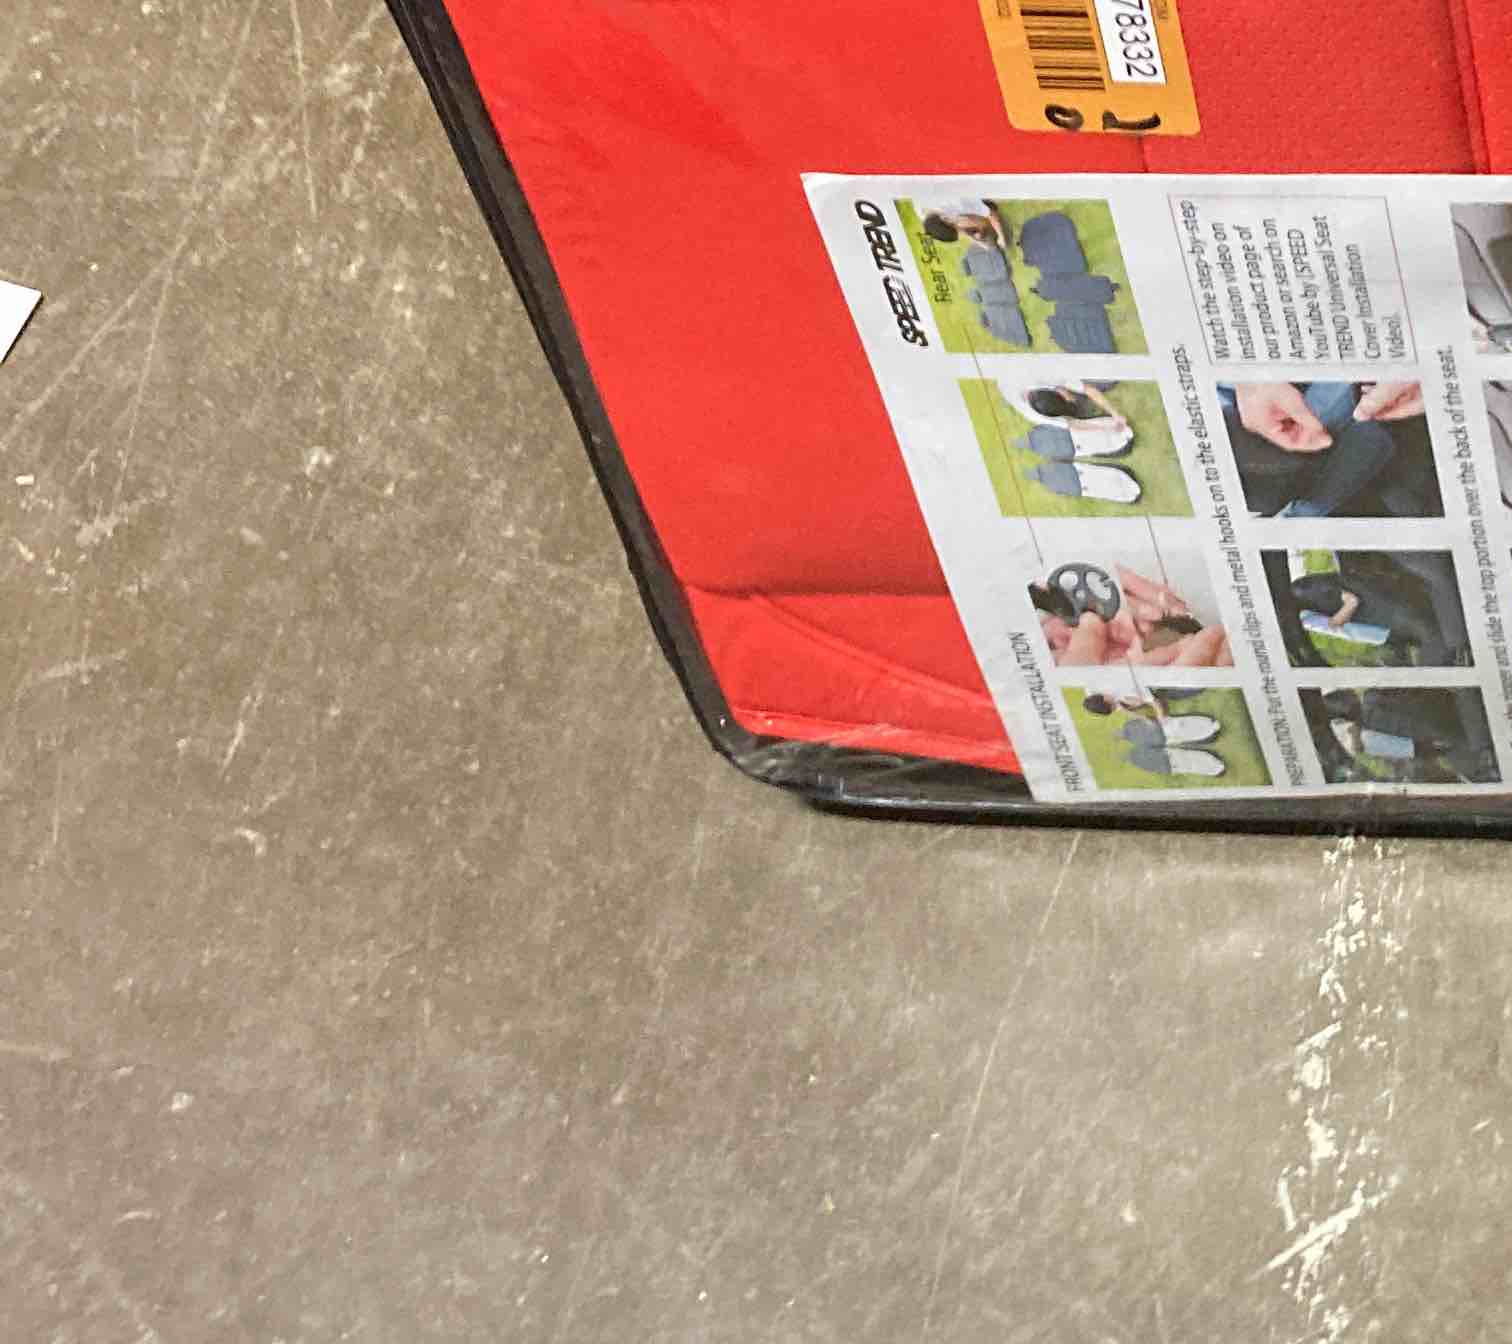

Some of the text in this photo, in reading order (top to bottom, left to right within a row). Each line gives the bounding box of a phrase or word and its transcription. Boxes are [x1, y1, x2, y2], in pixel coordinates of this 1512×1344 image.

[855, 201, 901, 270] TREND
[912, 231, 953, 303] Rear Seat
[1181, 201, 1229, 358] Watch the step-by-step
[1211, 222, 1254, 358] installation video on
[1232, 224, 1280, 359] our product page of
[1262, 218, 1304, 358] Amazon or search on
[1300, 281, 1319, 299] by
[1308, 215, 1353, 358] TREND Universal Seat
[1346, 244, 1380, 359] Cover Installation
[1306, 301, 1328, 358] YouTube
[1172, 344, 1195, 391] straps.
[1437, 346, 1456, 378] seat.
[1442, 382, 1461, 405] the
[1184, 395, 1207, 438] elastic
[1443, 408, 1464, 423] of
[1196, 441, 1214, 464] the
[1449, 426, 1471, 458] back
[1205, 467, 1219, 481] to
[1457, 461, 1475, 484] the
[1209, 484, 1224, 501] on
[1464, 487, 1481, 516] over
[1213, 505, 1234, 543] hooks
[1471, 519, 1493, 566] portion
[1221, 547, 1246, 582] metal
[1480, 569, 1495, 591] top
[1232, 585, 1253, 608] and
[1482, 593, 1498, 613] the
[1242, 611, 1261, 638] clips
[1486, 616, 1504, 643] slide
[1248, 639, 1270, 674] round
[1492, 645, 1509, 666] and
[1261, 676, 1277, 694] the
[1010, 632, 1080, 790] FRONT SEAT INSTALLATION
